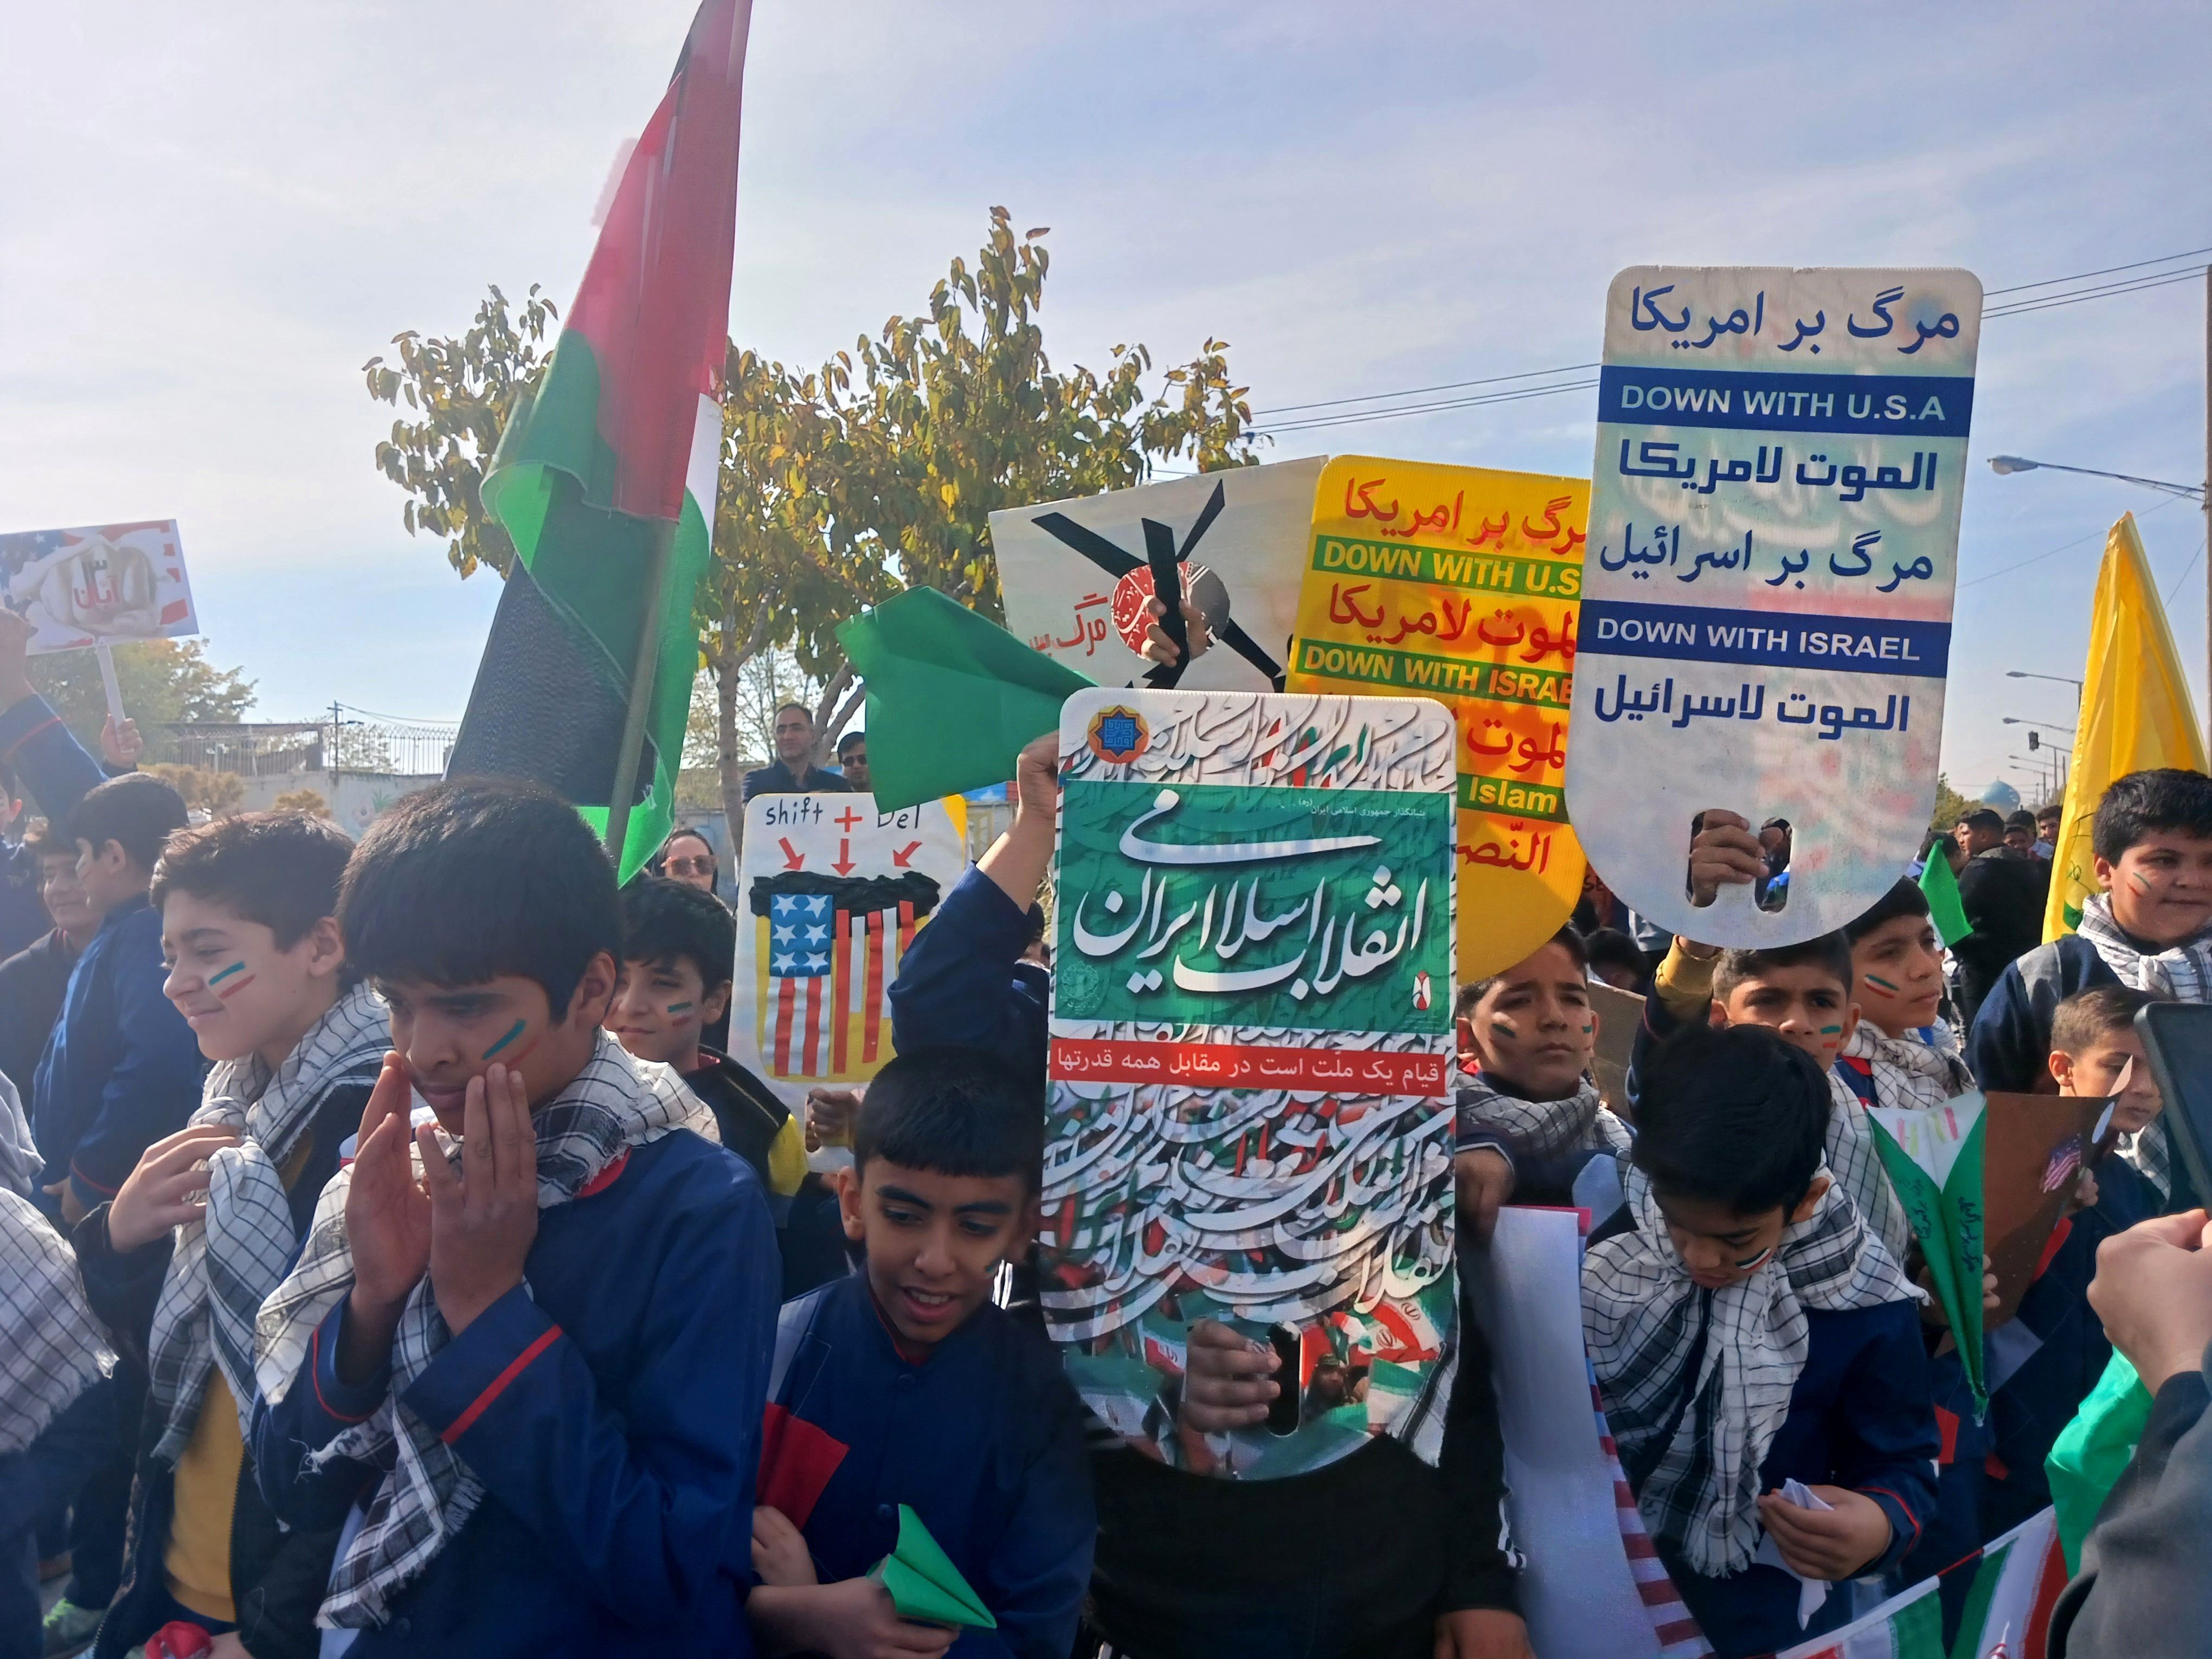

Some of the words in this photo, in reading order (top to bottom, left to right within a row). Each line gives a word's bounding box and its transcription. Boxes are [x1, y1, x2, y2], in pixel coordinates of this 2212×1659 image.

[1778, 309, 1825, 354] بر
[1847, 286, 1960, 354] مرگ
[1621, 384, 1731, 414] DOWN
[1744, 390, 1834, 418] WITH
[1847, 394, 1945, 421] U.S.A
[1795, 452, 1938, 501] الموت
[1466, 511, 1509, 554] بر
[1522, 496, 1586, 555] رگ
[1323, 541, 1422, 577] DOWN
[1433, 552, 1515, 590] WITH
[1526, 564, 1580, 595] U.S
[1599, 523, 1753, 583] اسرائیل
[1765, 547, 1809, 590] بر
[1829, 529, 1933, 592] مرگ
[1477, 612, 1576, 663] لموت
[1597, 618, 1695, 646] DOWN
[1707, 625, 1787, 652] WITH
[1799, 631, 1920, 661] ISRAEL
[1304, 646, 1393, 682] DOWN
[1405, 658, 1478, 690] WITH
[1489, 669, 1573, 703] ISRAE
[1777, 693, 1911, 741] الموت
[1467, 721, 1565, 772] لموت
[1469, 776, 1557, 813] Islam
[1058, 1047, 1112, 1071] قدرتها
[1121, 1053, 1161, 1070] همه
[1169, 1053, 1220, 1077] مقابل
[1228, 1059, 1251, 1077] در
[1259, 1058, 1303, 1075] است
[1362, 1060, 1392, 1085] یک
[1402, 1063, 1439, 1090] قیام
